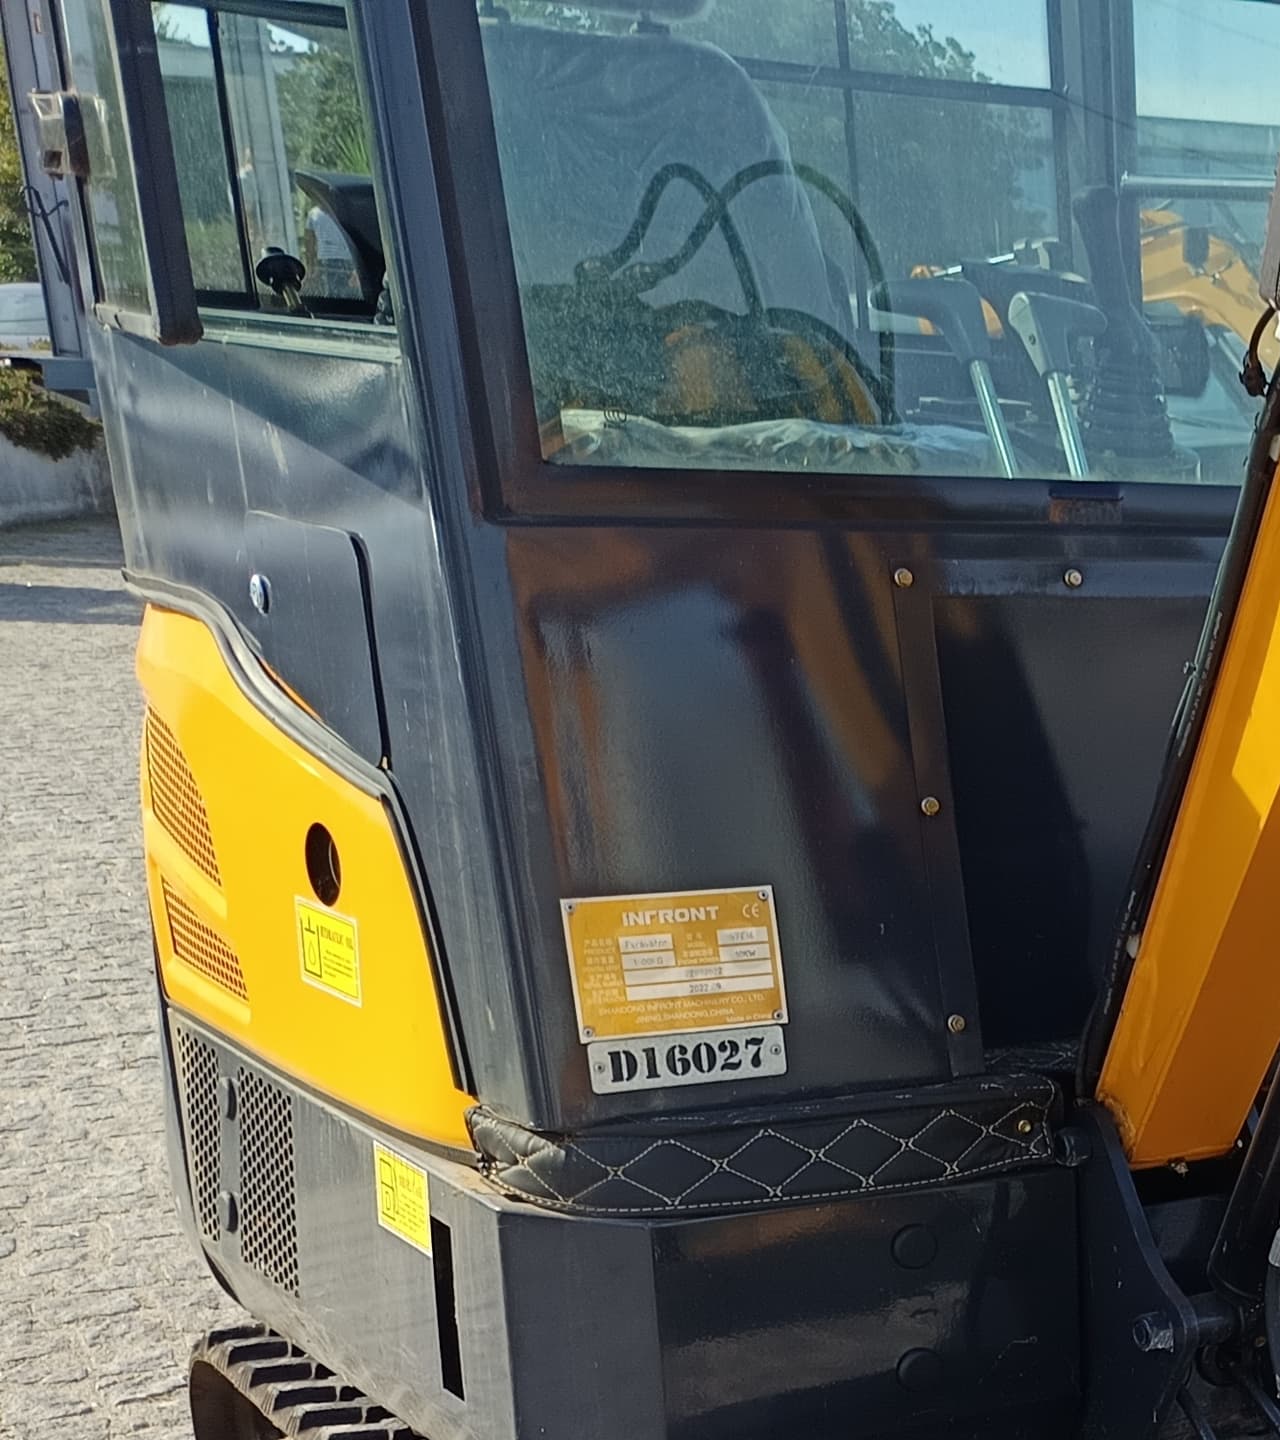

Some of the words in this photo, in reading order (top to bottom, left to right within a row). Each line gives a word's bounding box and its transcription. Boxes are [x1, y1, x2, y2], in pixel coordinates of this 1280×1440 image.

[622, 905, 719, 928] INFRONT
[742, 902, 759, 918] CE
[607, 1036, 765, 1083] D16027
